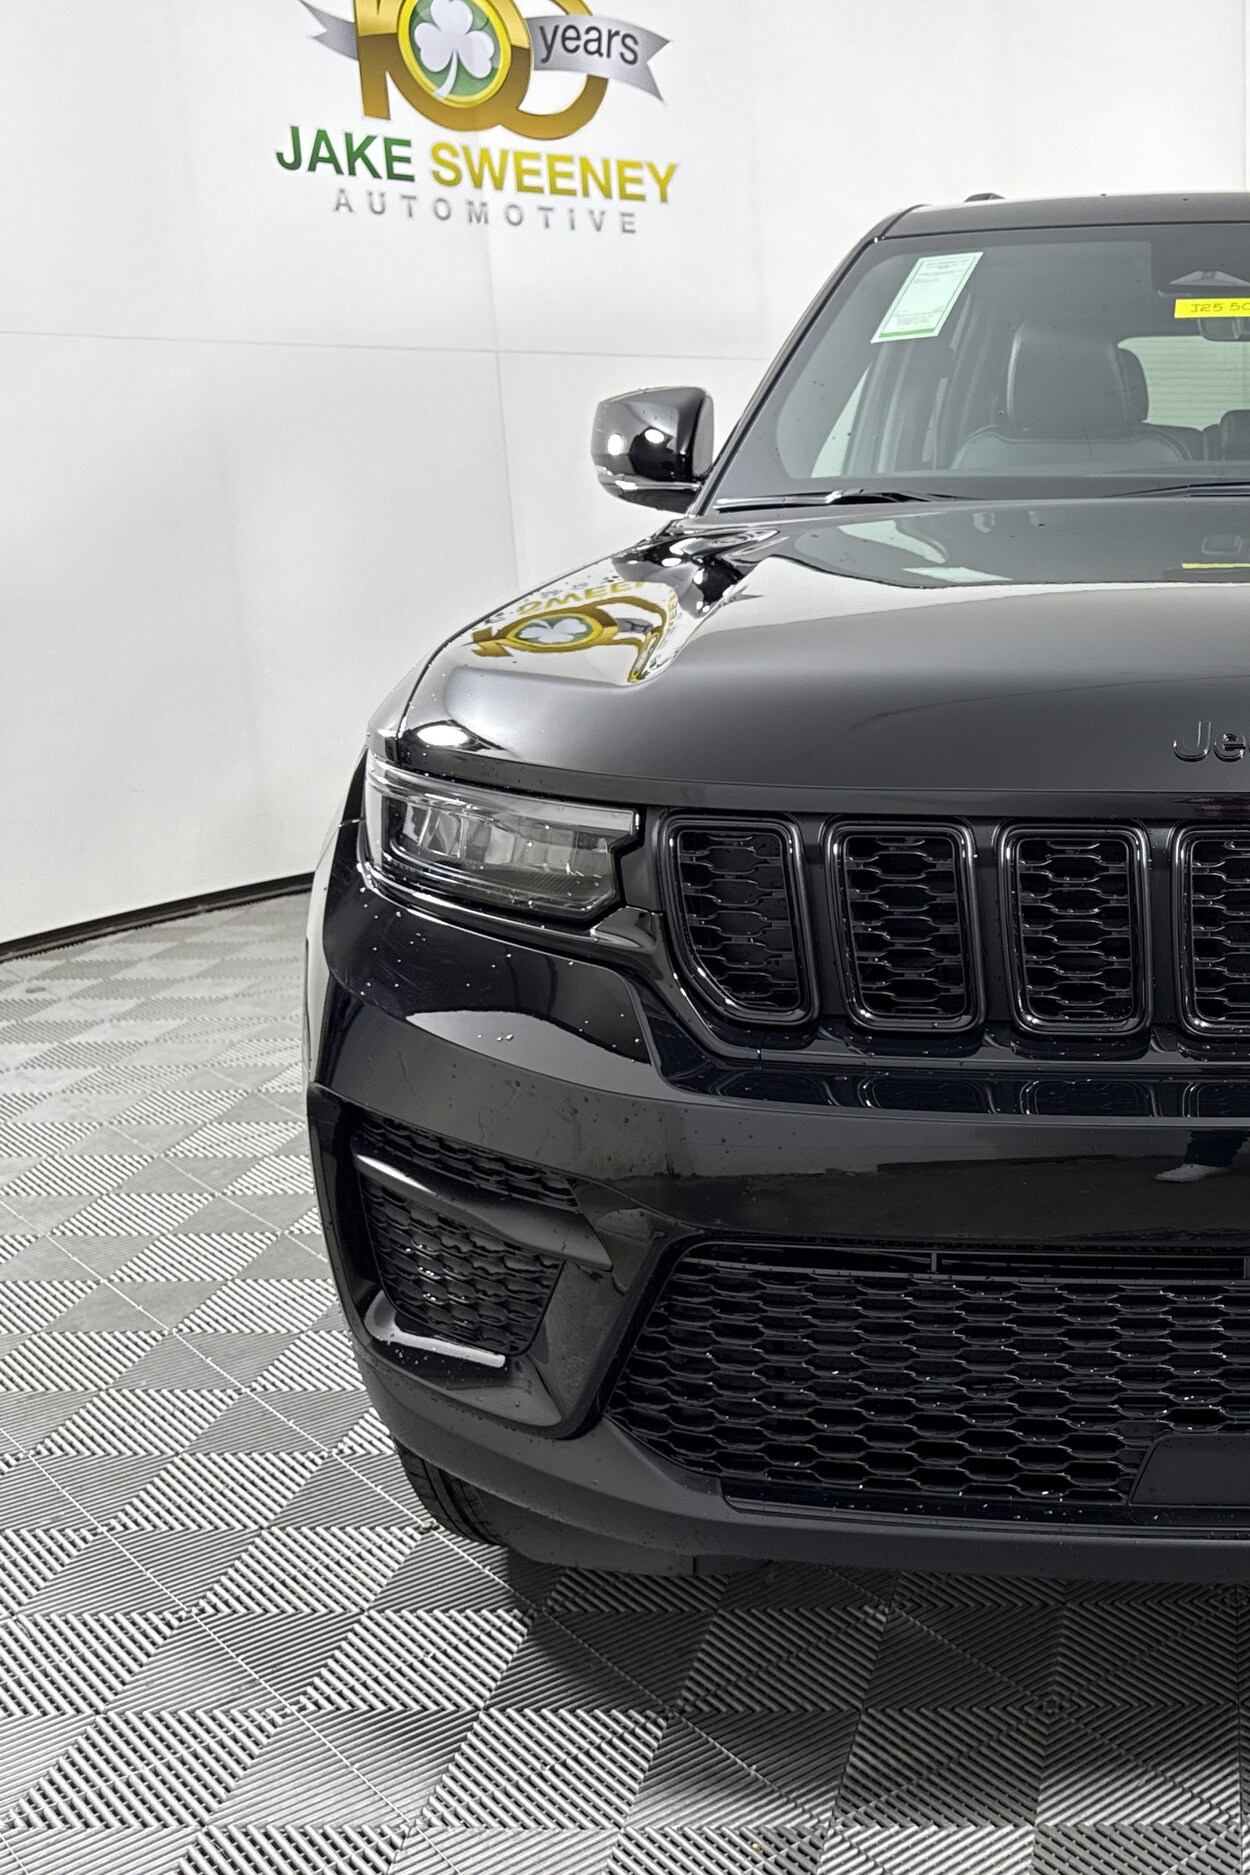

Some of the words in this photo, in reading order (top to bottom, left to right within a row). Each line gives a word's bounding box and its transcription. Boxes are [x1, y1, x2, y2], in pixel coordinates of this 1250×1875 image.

[538, 23, 640, 66] years
[276, 126, 416, 183] JAKE
[430, 142, 677, 204] SWEENEY
[334, 189, 636, 234] AUTOMOTIVE
